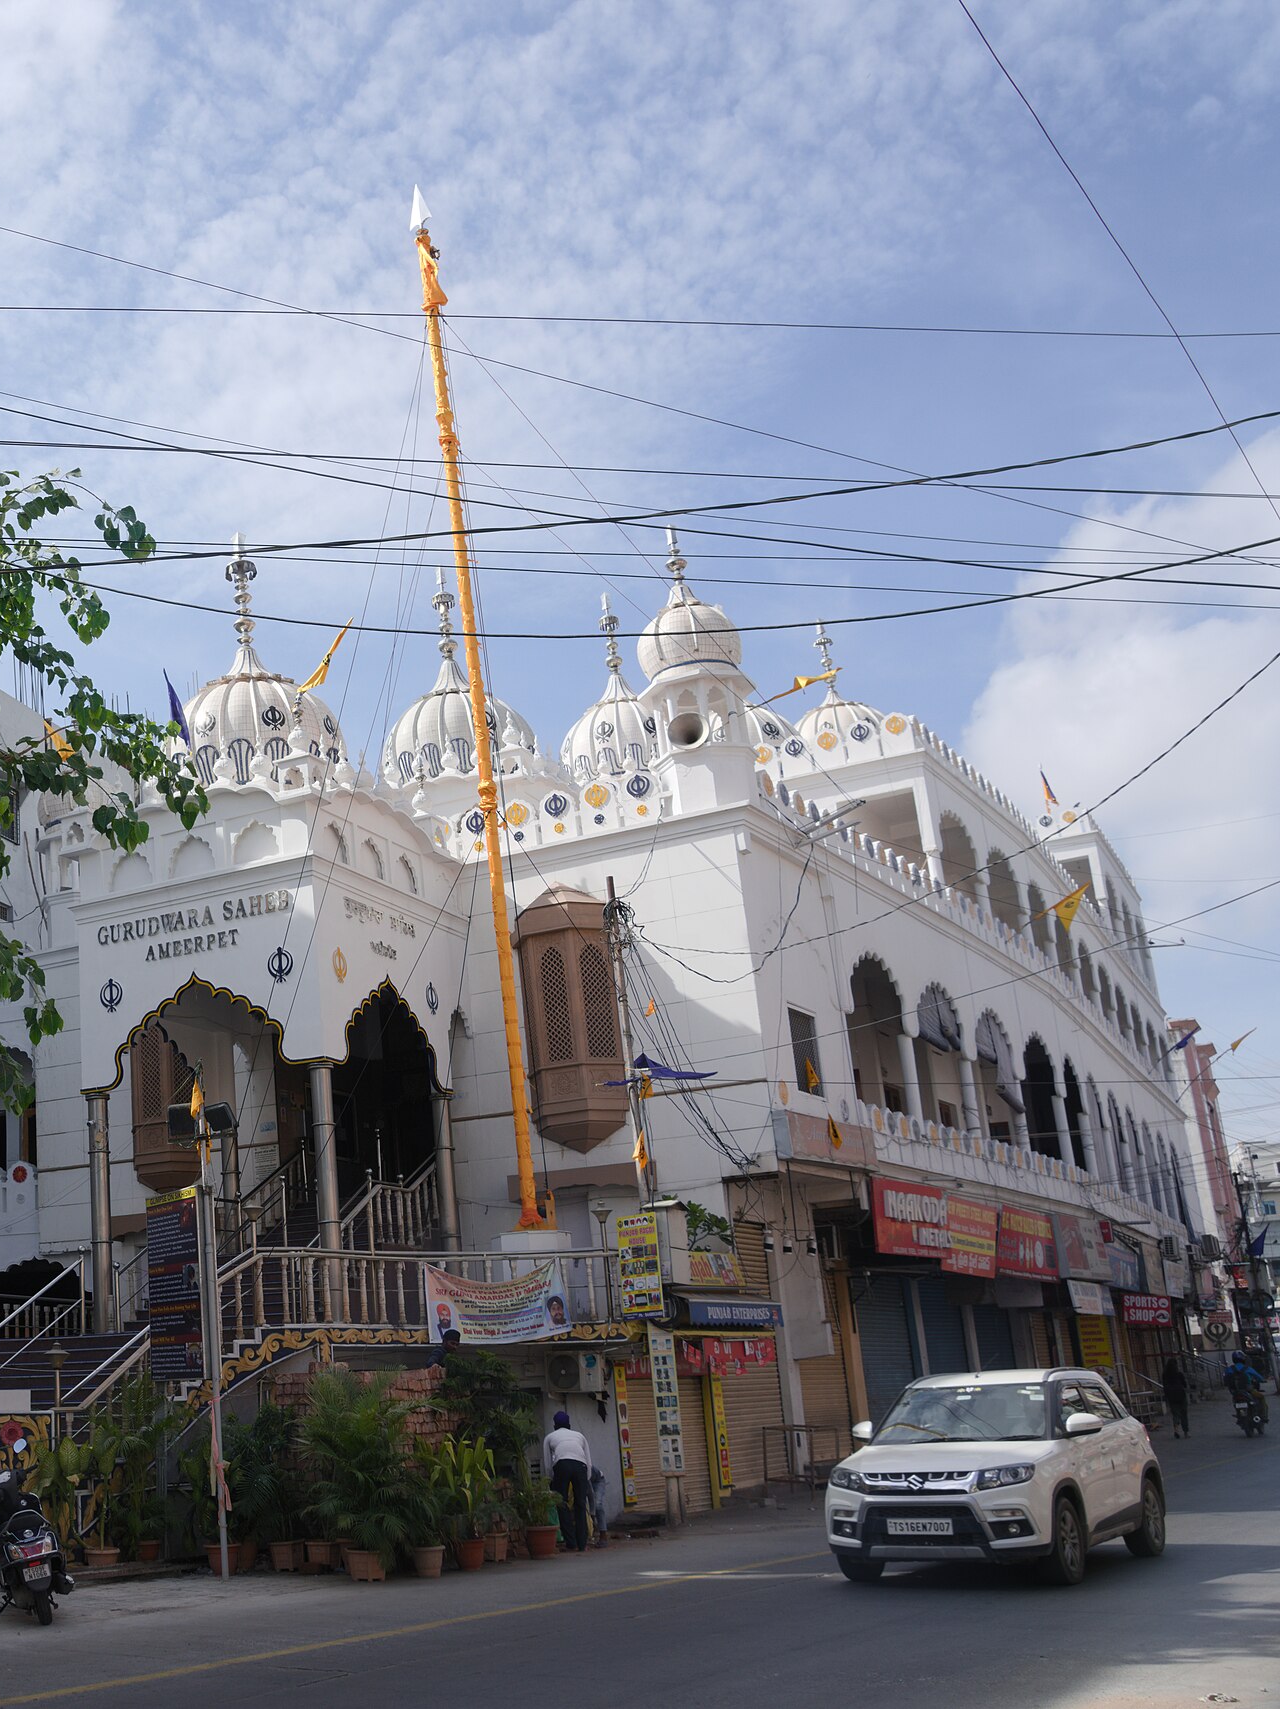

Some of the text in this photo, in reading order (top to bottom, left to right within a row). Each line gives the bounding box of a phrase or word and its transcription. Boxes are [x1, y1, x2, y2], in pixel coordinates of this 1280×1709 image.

[97, 889, 290, 946] GURUDWARA SAHEB
[145, 929, 239, 962] AMEERPET
[918, 1227, 954, 1249] METALS
[435, 1287, 447, 1296] SRI
[474, 1291, 515, 1300] AMARDAS
[1123, 1295, 1158, 1308] SPORTS
[707, 1306, 770, 1320] PUNJAB ENTERPRISES
[1129, 1308, 1156, 1322] SHOP
[892, 1521, 950, 1532] TS16EN7007
